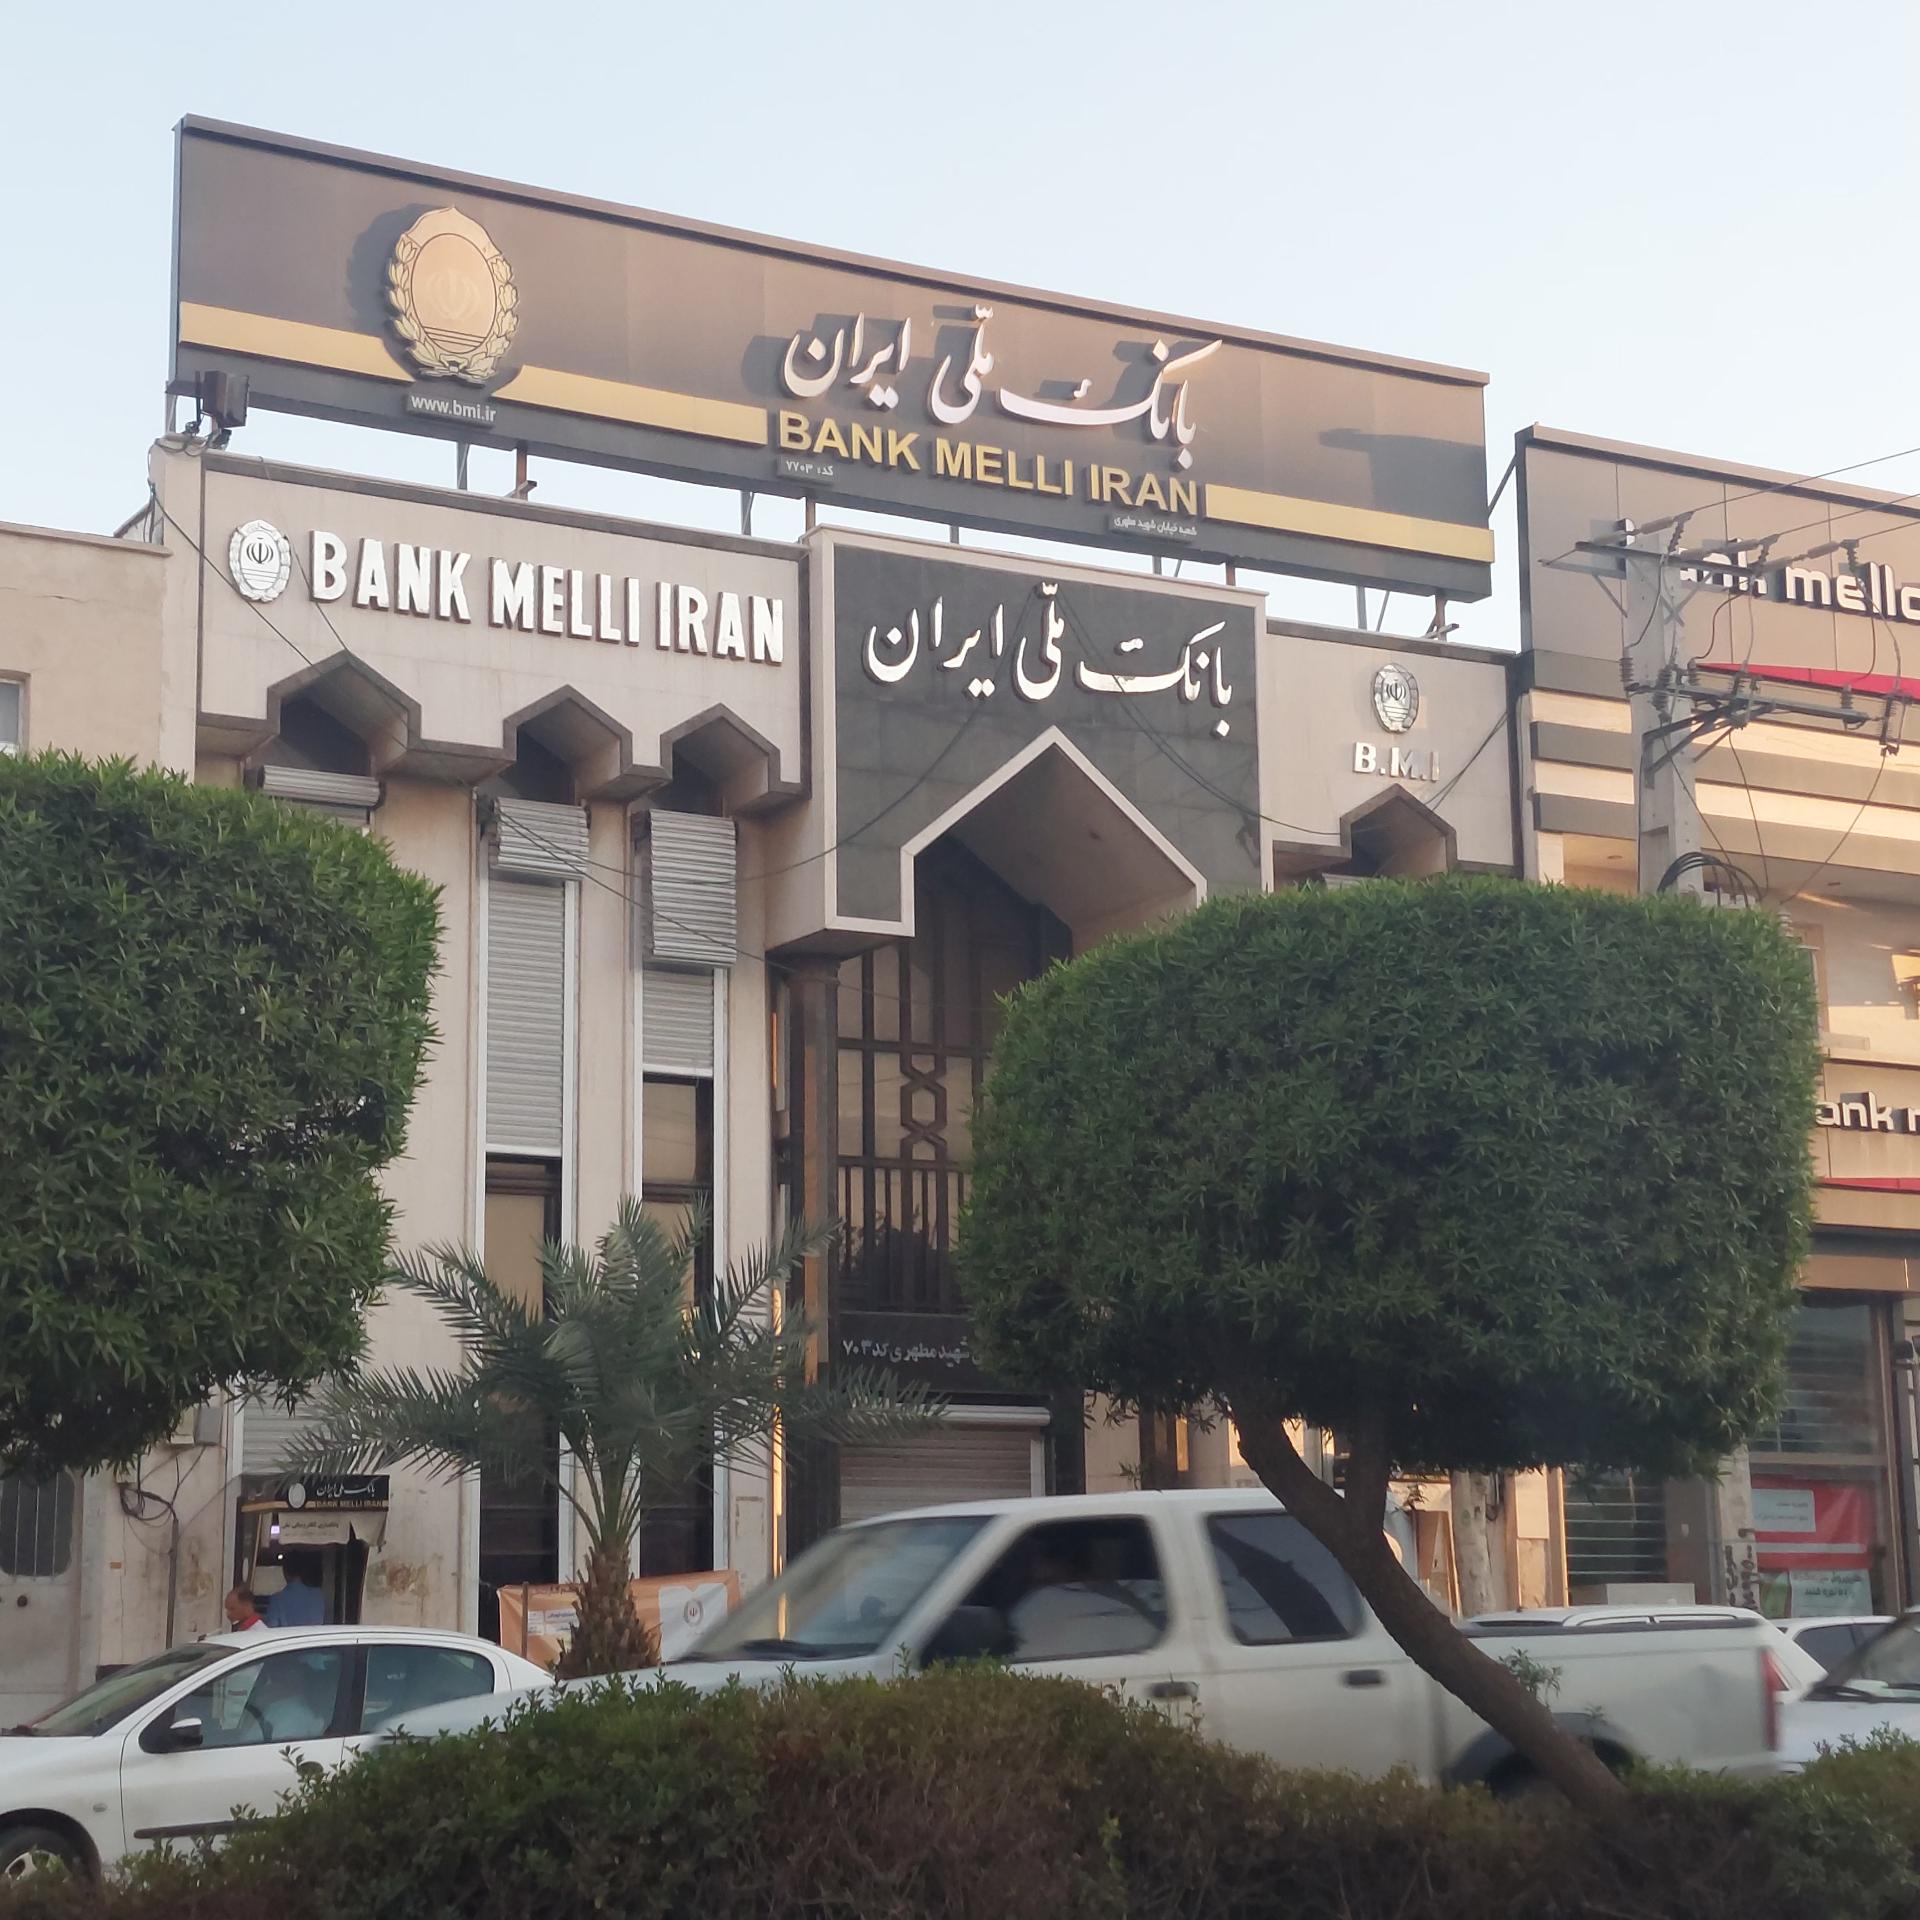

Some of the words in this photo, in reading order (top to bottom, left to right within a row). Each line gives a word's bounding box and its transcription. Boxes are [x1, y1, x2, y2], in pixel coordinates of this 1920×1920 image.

[410, 395, 497, 423] www.bmi.ir
[784, 311, 912, 409] ایران
[1000, 338, 1223, 470] بانک
[779, 409, 921, 471] BANK
[935, 437, 1074, 497] MELLI
[1089, 463, 1198, 516] IRAN
[785, 460, 814, 475] ۷۷۰۳
[310, 529, 472, 624] BANK
[489, 556, 640, 647] MELLI
[656, 580, 785, 666] IRAN
[864, 595, 1004, 698] ایران
[1076, 620, 1233, 738] بانک
[889, 1342, 938, 1363] مطهری
